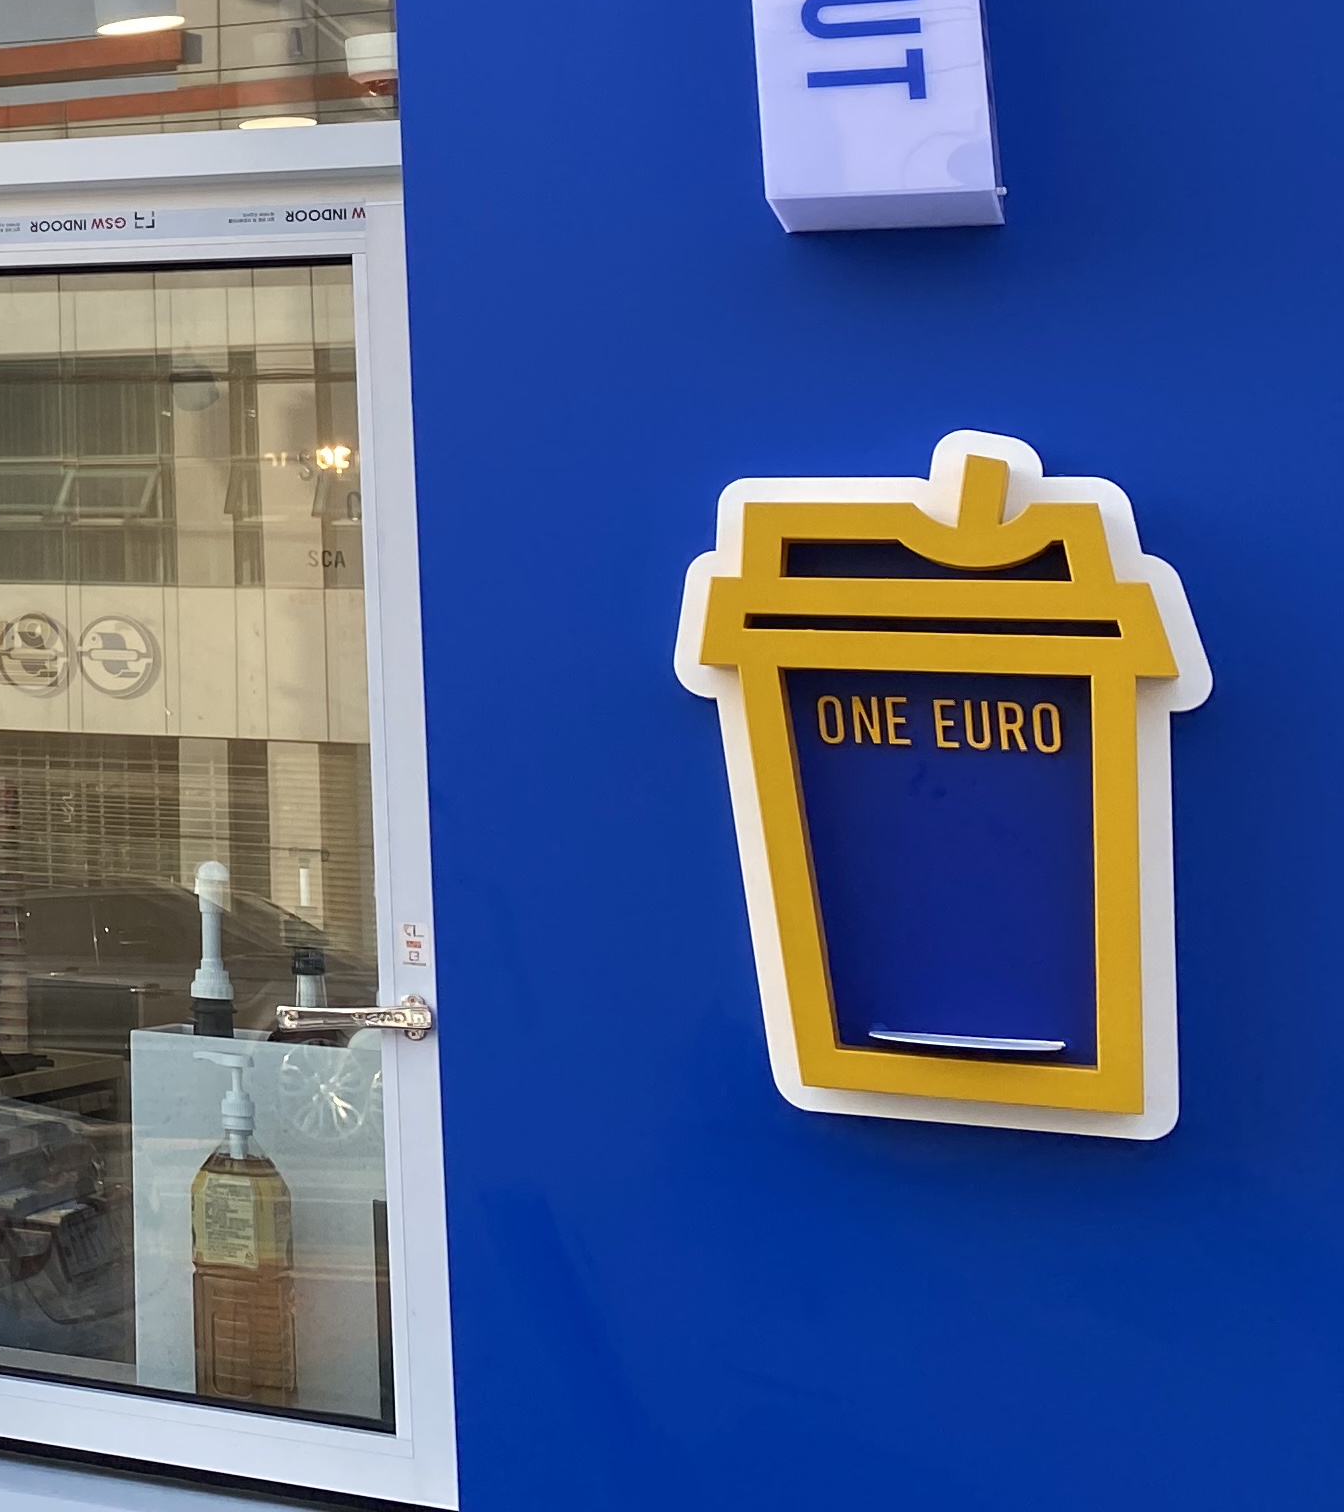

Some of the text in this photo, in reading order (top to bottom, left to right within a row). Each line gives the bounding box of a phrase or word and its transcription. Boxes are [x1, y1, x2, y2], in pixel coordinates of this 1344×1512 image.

[91, 216, 127, 231] GSW
[285, 207, 348, 224] INDOOR
[30, 219, 88, 234] INDOOR
[816, 694, 1065, 755] ONE EURO
